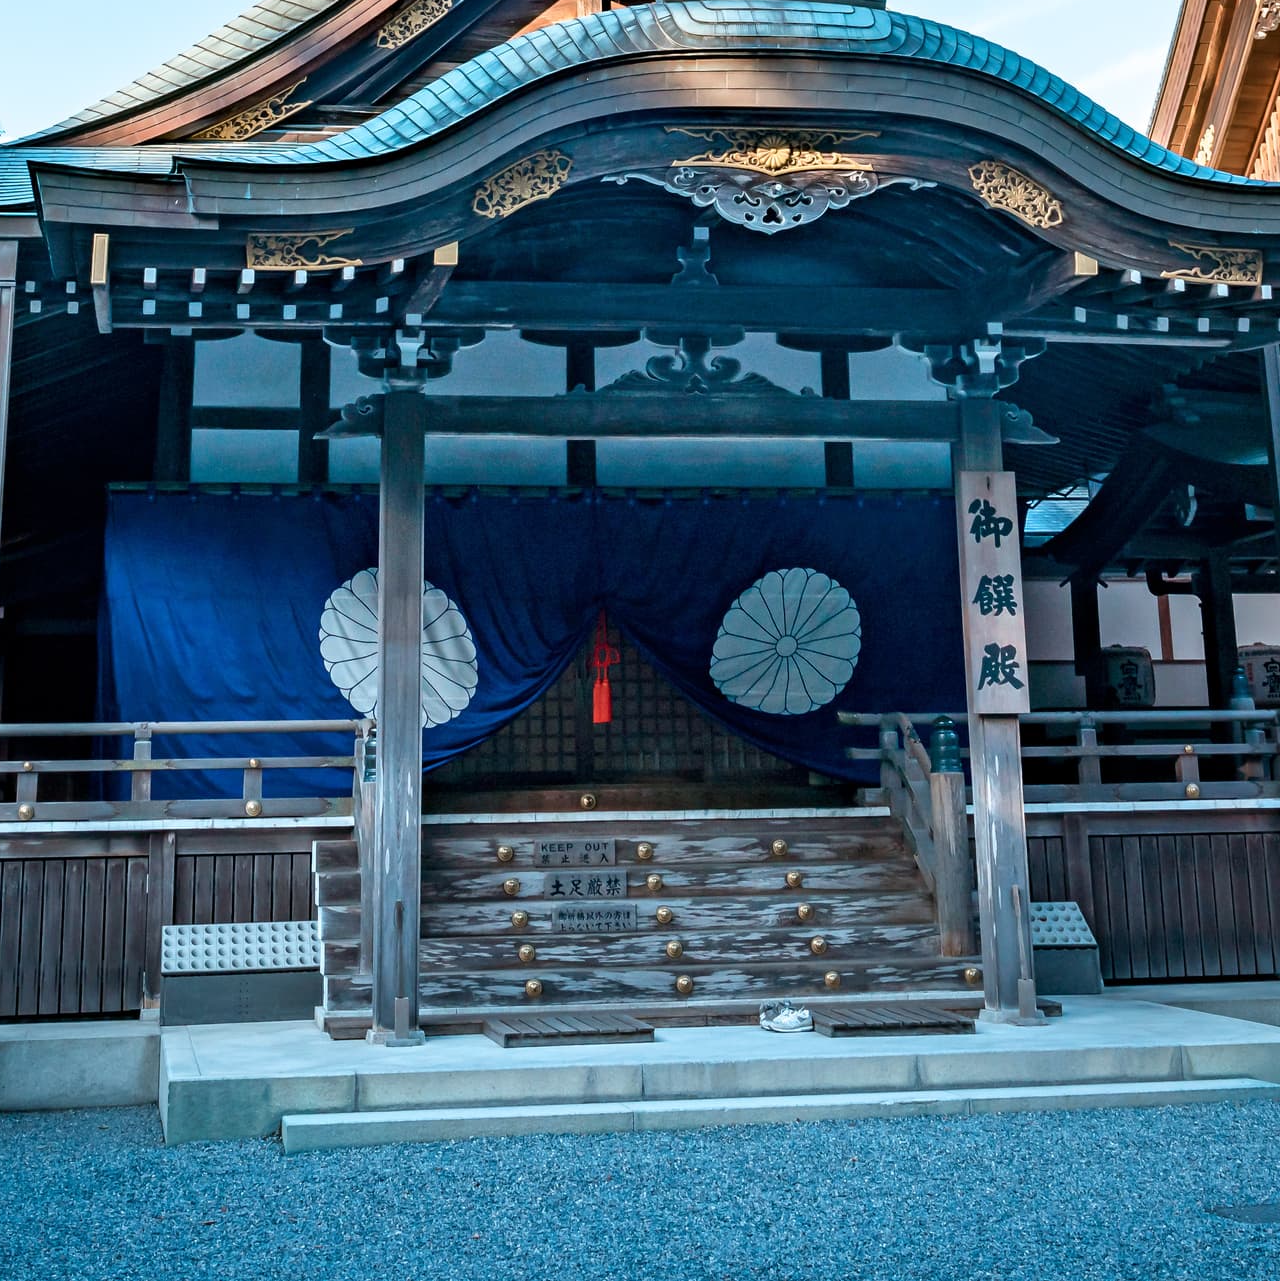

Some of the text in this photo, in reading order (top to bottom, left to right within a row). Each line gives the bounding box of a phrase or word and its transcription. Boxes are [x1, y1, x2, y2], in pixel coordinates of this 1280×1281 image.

[968, 498, 1025, 691] 御饌殿
[541, 842, 609, 852] KEEP OUT
[550, 875, 621, 896] 土足厳禁
